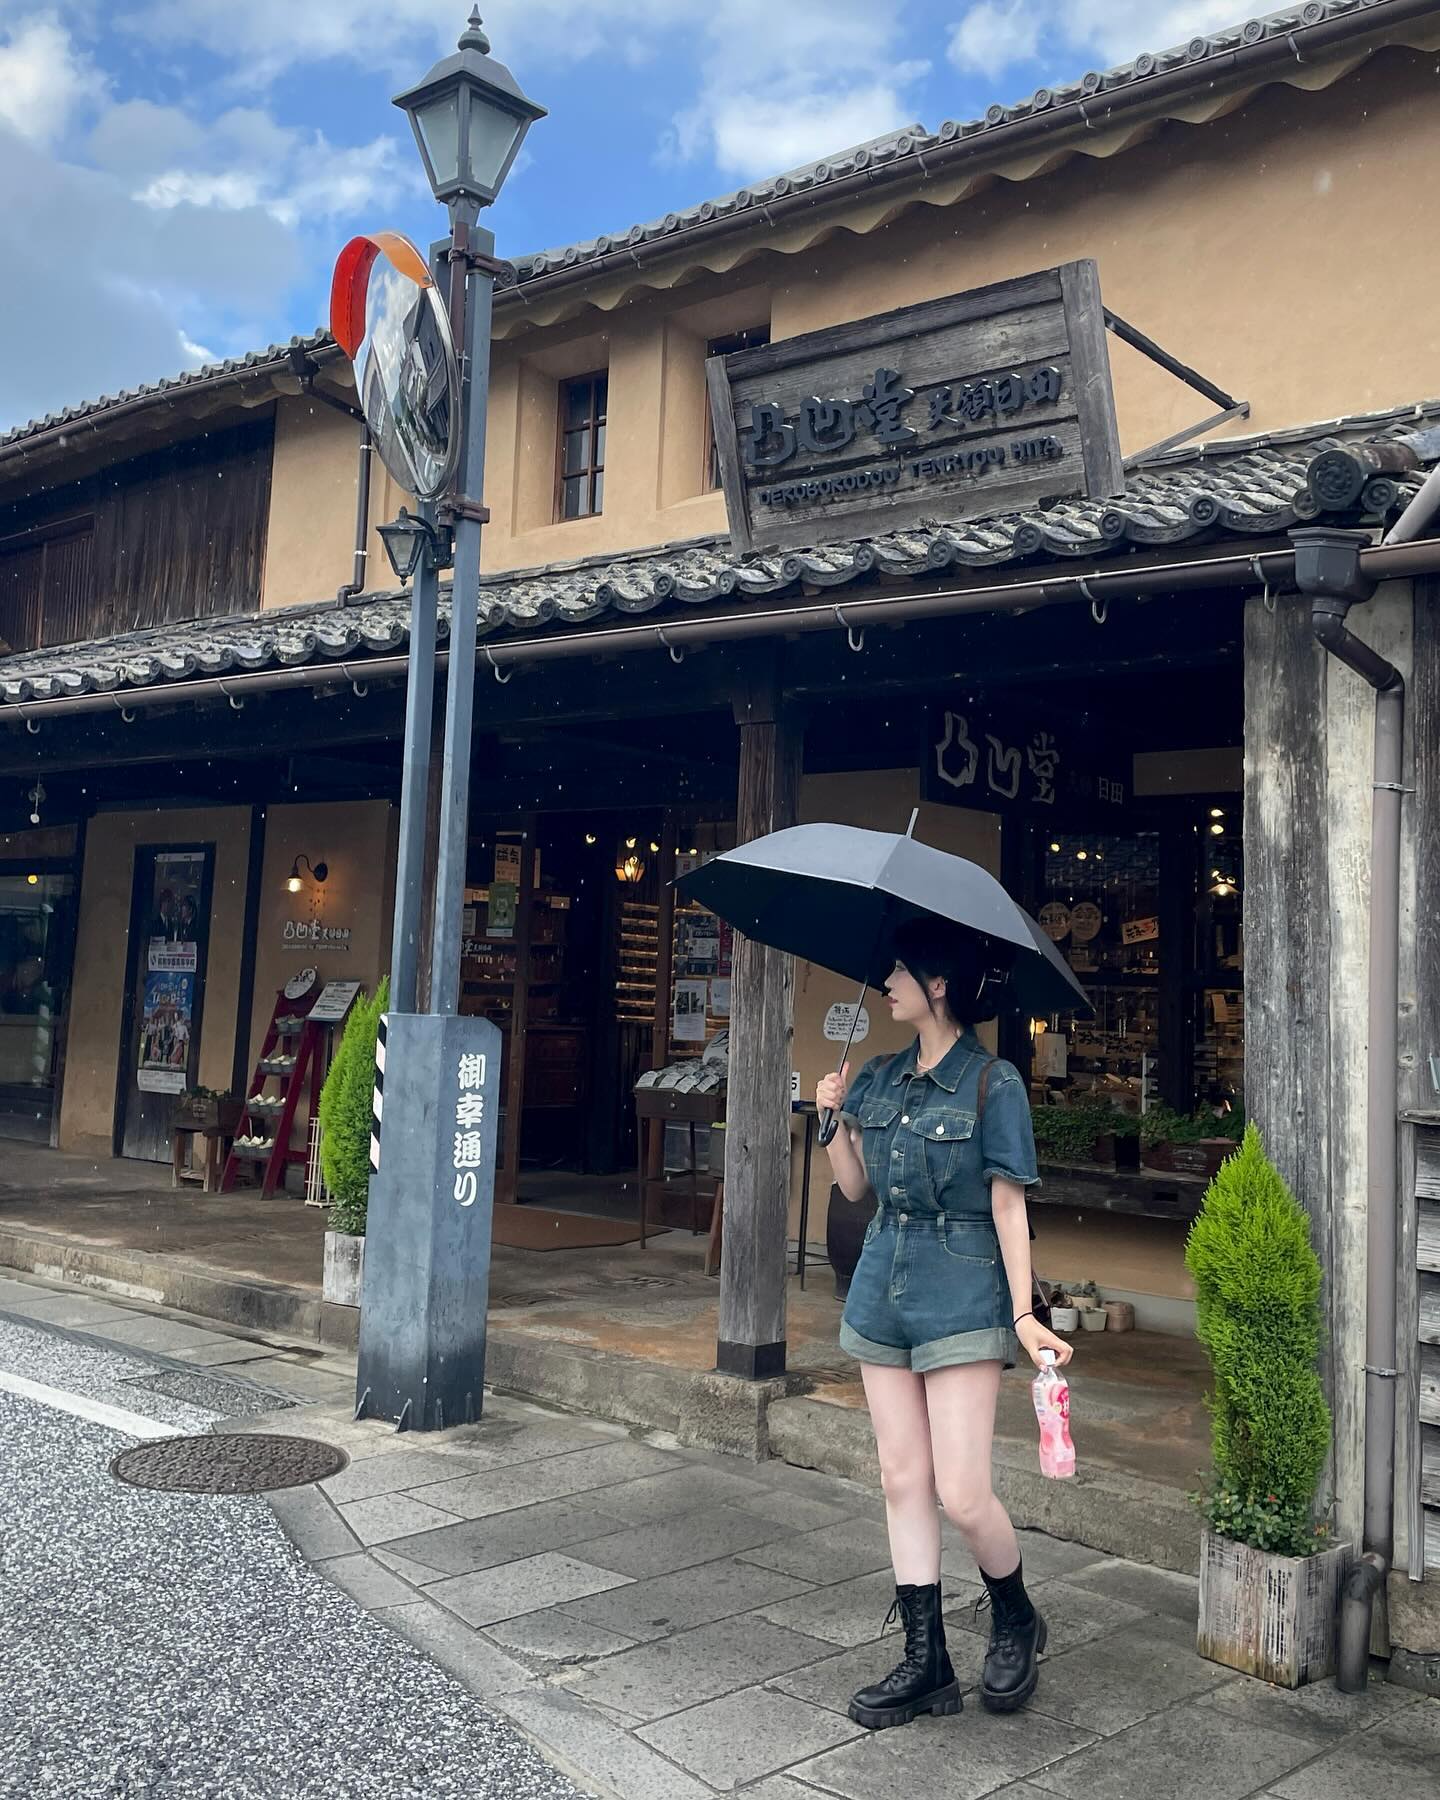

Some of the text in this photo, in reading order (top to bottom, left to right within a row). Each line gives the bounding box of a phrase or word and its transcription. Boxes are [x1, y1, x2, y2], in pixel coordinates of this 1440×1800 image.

[746, 367, 917, 465] 凸凹堂
[758, 435, 1063, 506] DEKOBOKODOU TENRYOU HITA
[453, 1053, 486, 1207] 御幸通り
